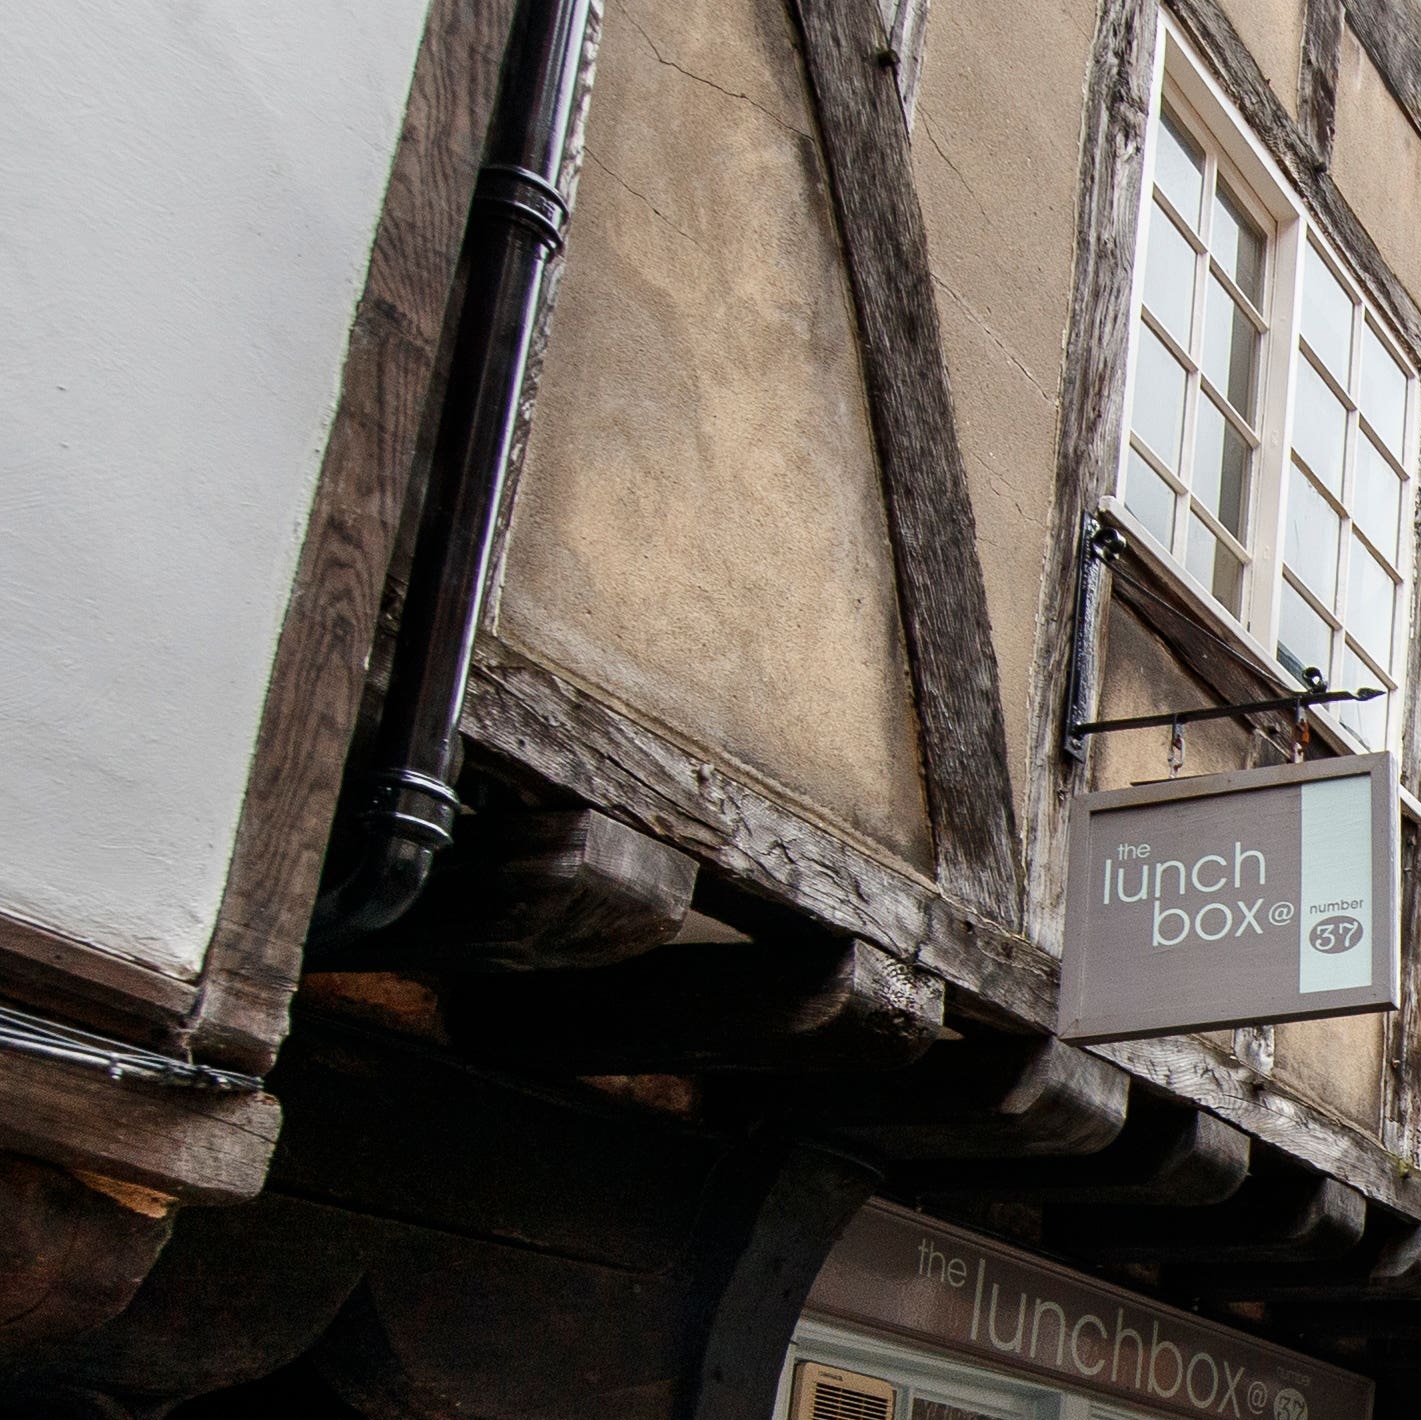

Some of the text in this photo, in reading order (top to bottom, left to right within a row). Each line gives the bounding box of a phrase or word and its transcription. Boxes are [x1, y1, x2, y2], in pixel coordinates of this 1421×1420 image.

[1104, 842, 1266, 904] lunch
[1118, 843, 1150, 860] the
[1153, 899, 1294, 946] box @
[1310, 899, 1364, 914] number
[1315, 921, 1358, 950] 37
[918, 1238, 967, 1287] the
[970, 1259, 1267, 1418] lunchbox @
